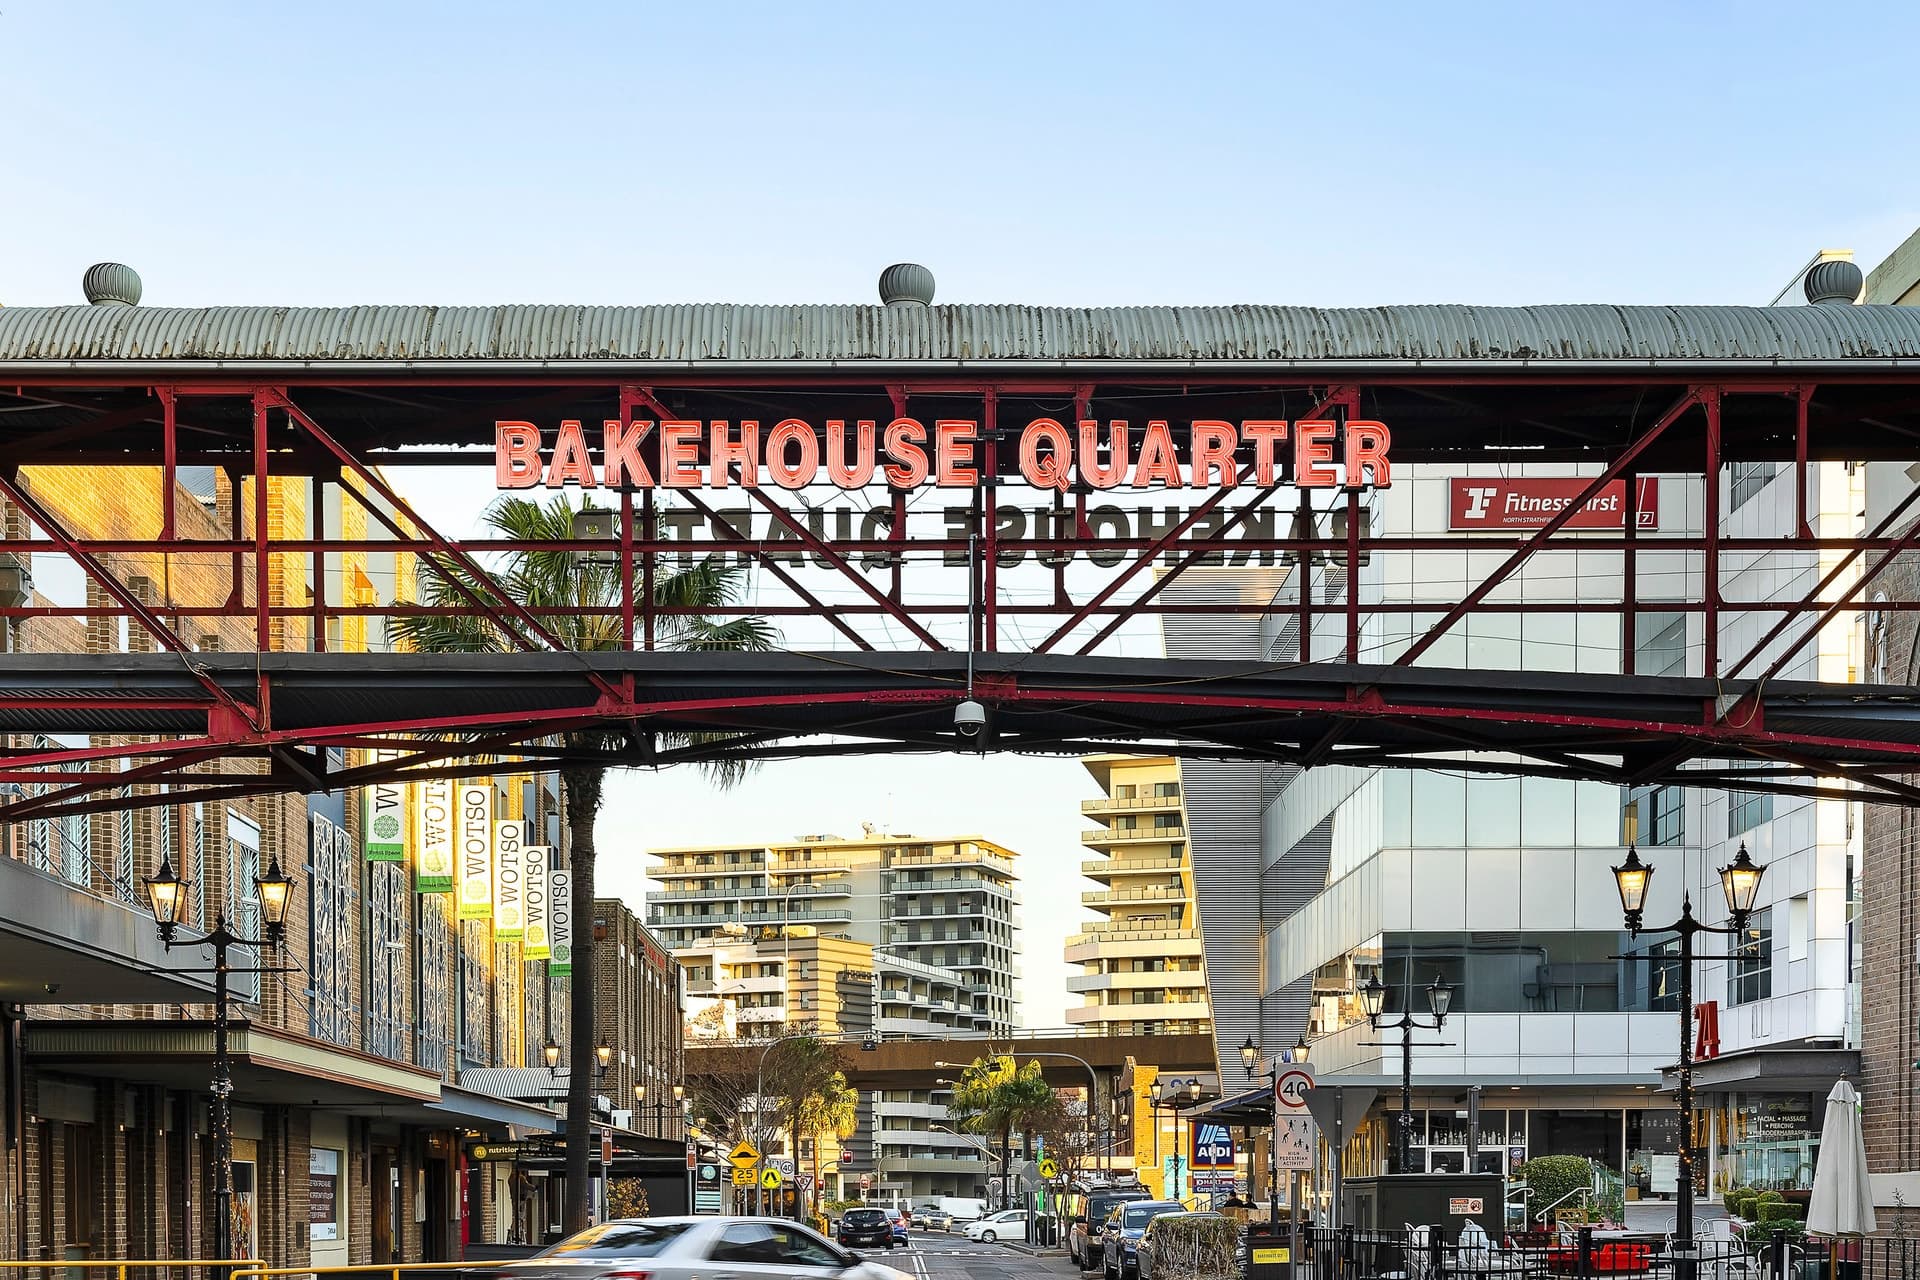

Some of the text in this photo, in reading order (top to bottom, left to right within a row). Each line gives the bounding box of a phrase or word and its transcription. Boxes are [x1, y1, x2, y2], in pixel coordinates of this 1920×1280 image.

[495, 418, 1391, 493] BAKEHOUSE QUARTER
[1505, 492, 1619, 514] Fitness irst
[465, 789, 486, 879] WOTSO
[500, 824, 520, 906] WOTSO
[526, 849, 543, 926] WOTSO
[552, 873, 569, 945] WOTSO
[1283, 1081, 1308, 1098] 40
[737, 1169, 754, 1178] 25
